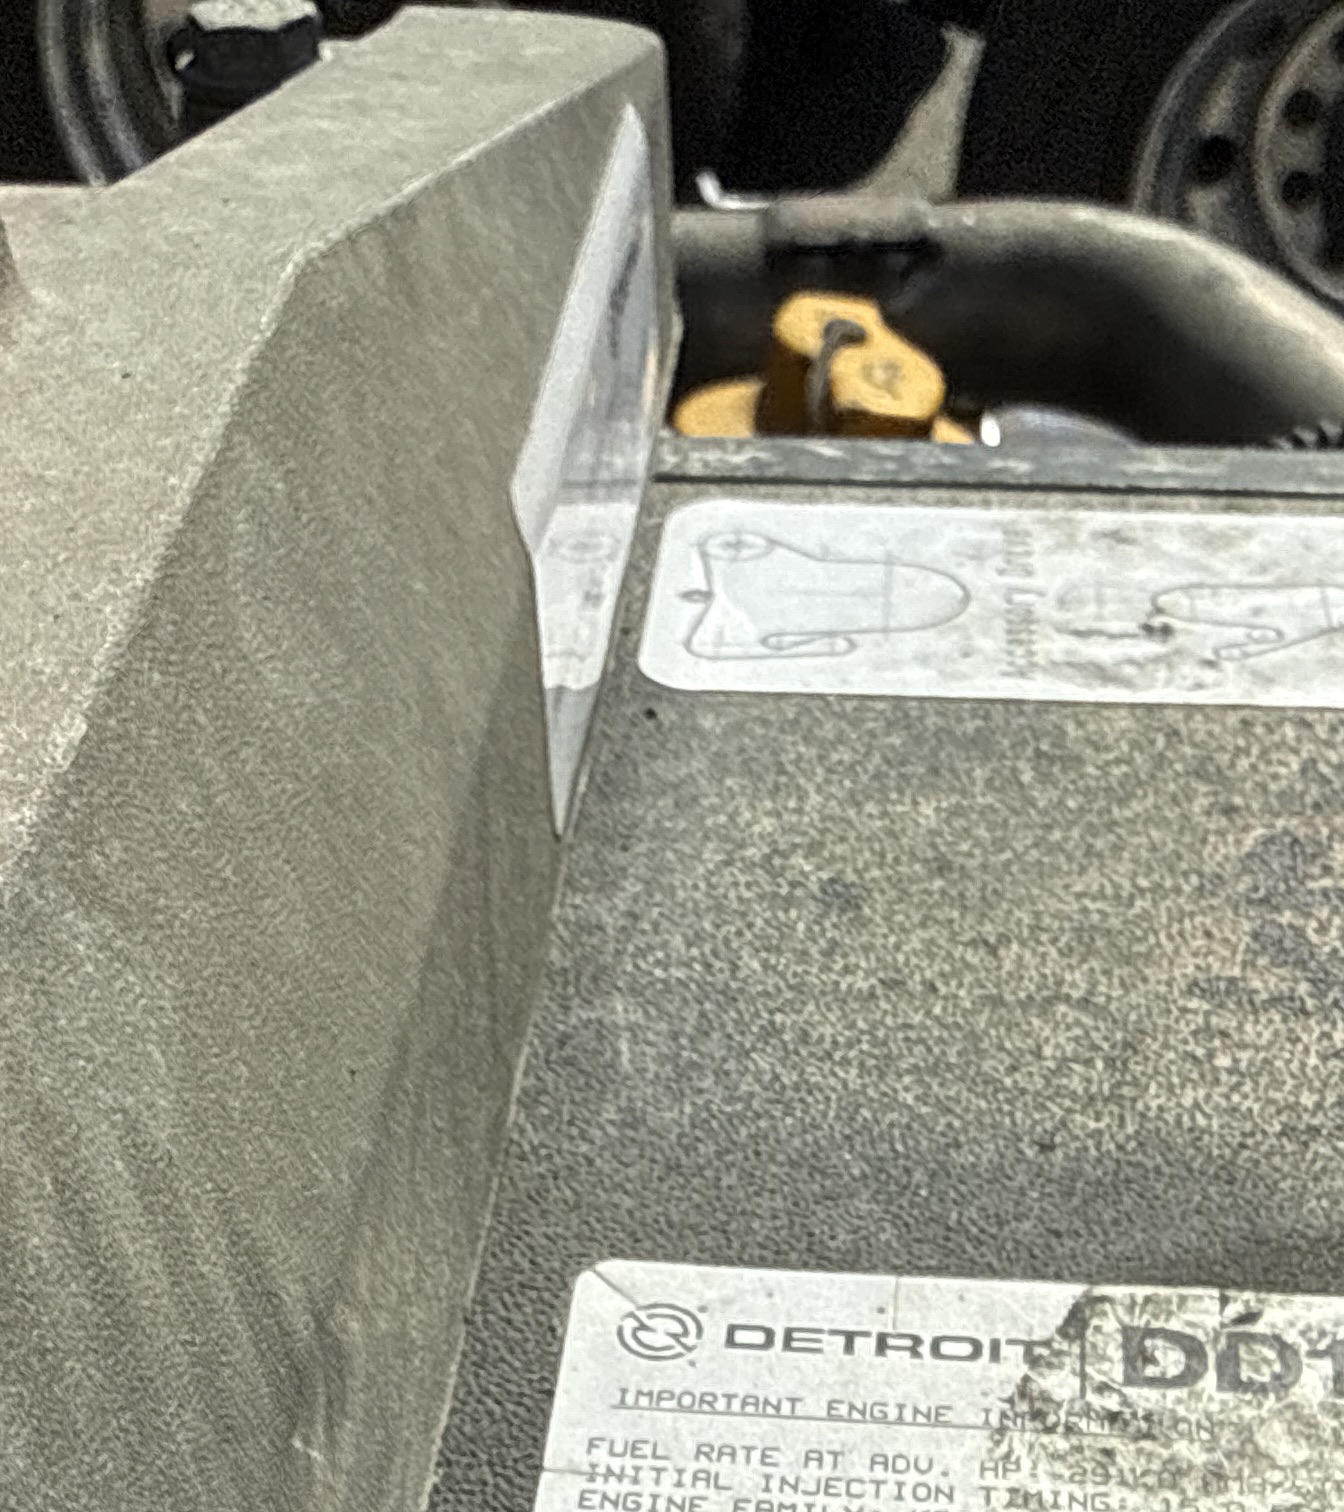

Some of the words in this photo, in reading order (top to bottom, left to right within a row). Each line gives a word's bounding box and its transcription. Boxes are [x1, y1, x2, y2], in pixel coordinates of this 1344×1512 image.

[724, 1321, 1050, 1364] DETROIT
[617, 1386, 805, 1413] IMPORTANT
[826, 1398, 953, 1422] ENGINE
[585, 1435, 672, 1460] FUEL
[694, 1441, 781, 1467] RATE
[803, 1448, 846, 1471] AT
[869, 1452, 951, 1478] ADV.
[583, 1461, 735, 1491] INITIAL
[759, 1472, 955, 1505] INJECTION
